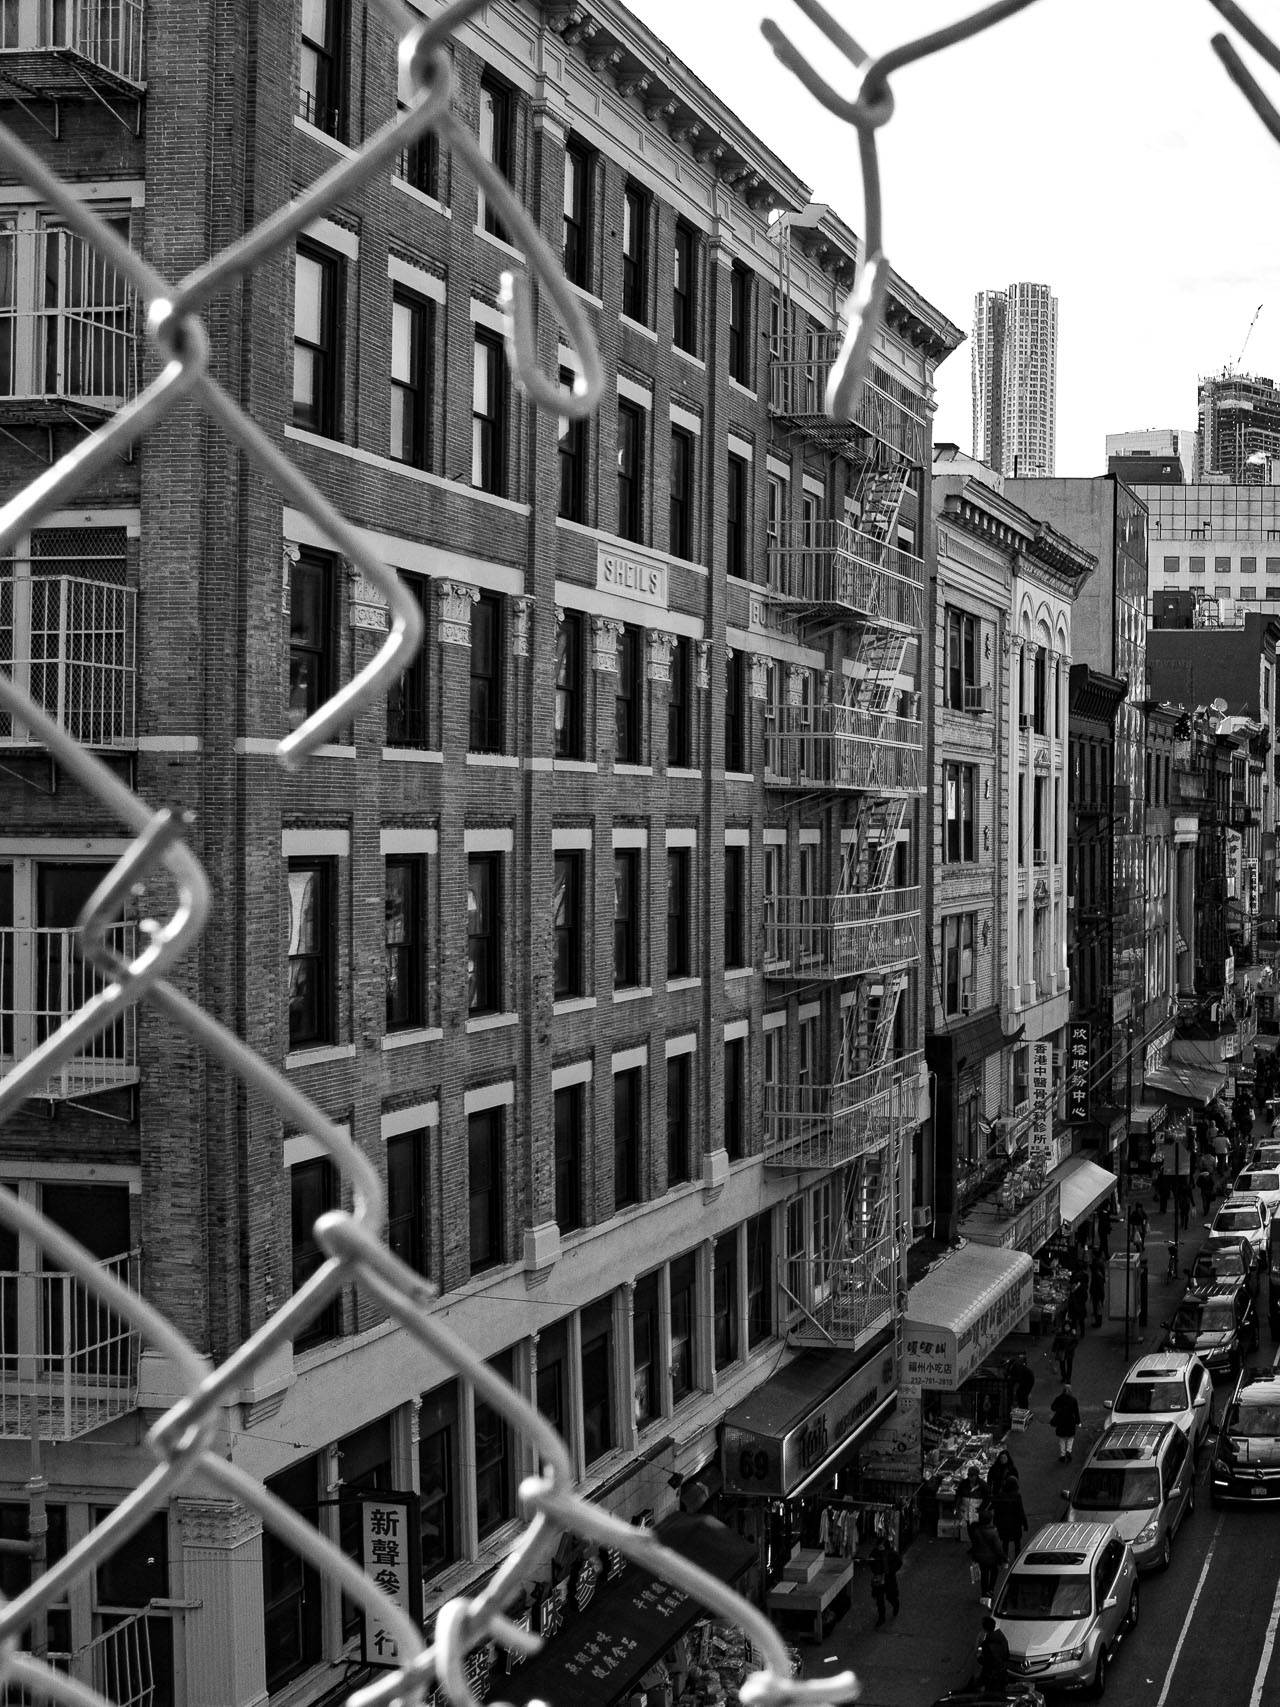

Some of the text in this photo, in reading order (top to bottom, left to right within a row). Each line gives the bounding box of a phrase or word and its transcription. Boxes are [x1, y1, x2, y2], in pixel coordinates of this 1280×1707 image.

[603, 556, 658, 595] SHEILS
[908, 1362, 952, 1375] 福州小吃店
[739, 1448, 769, 1480] 69
[370, 1508, 401, 1657] 新聲參行
